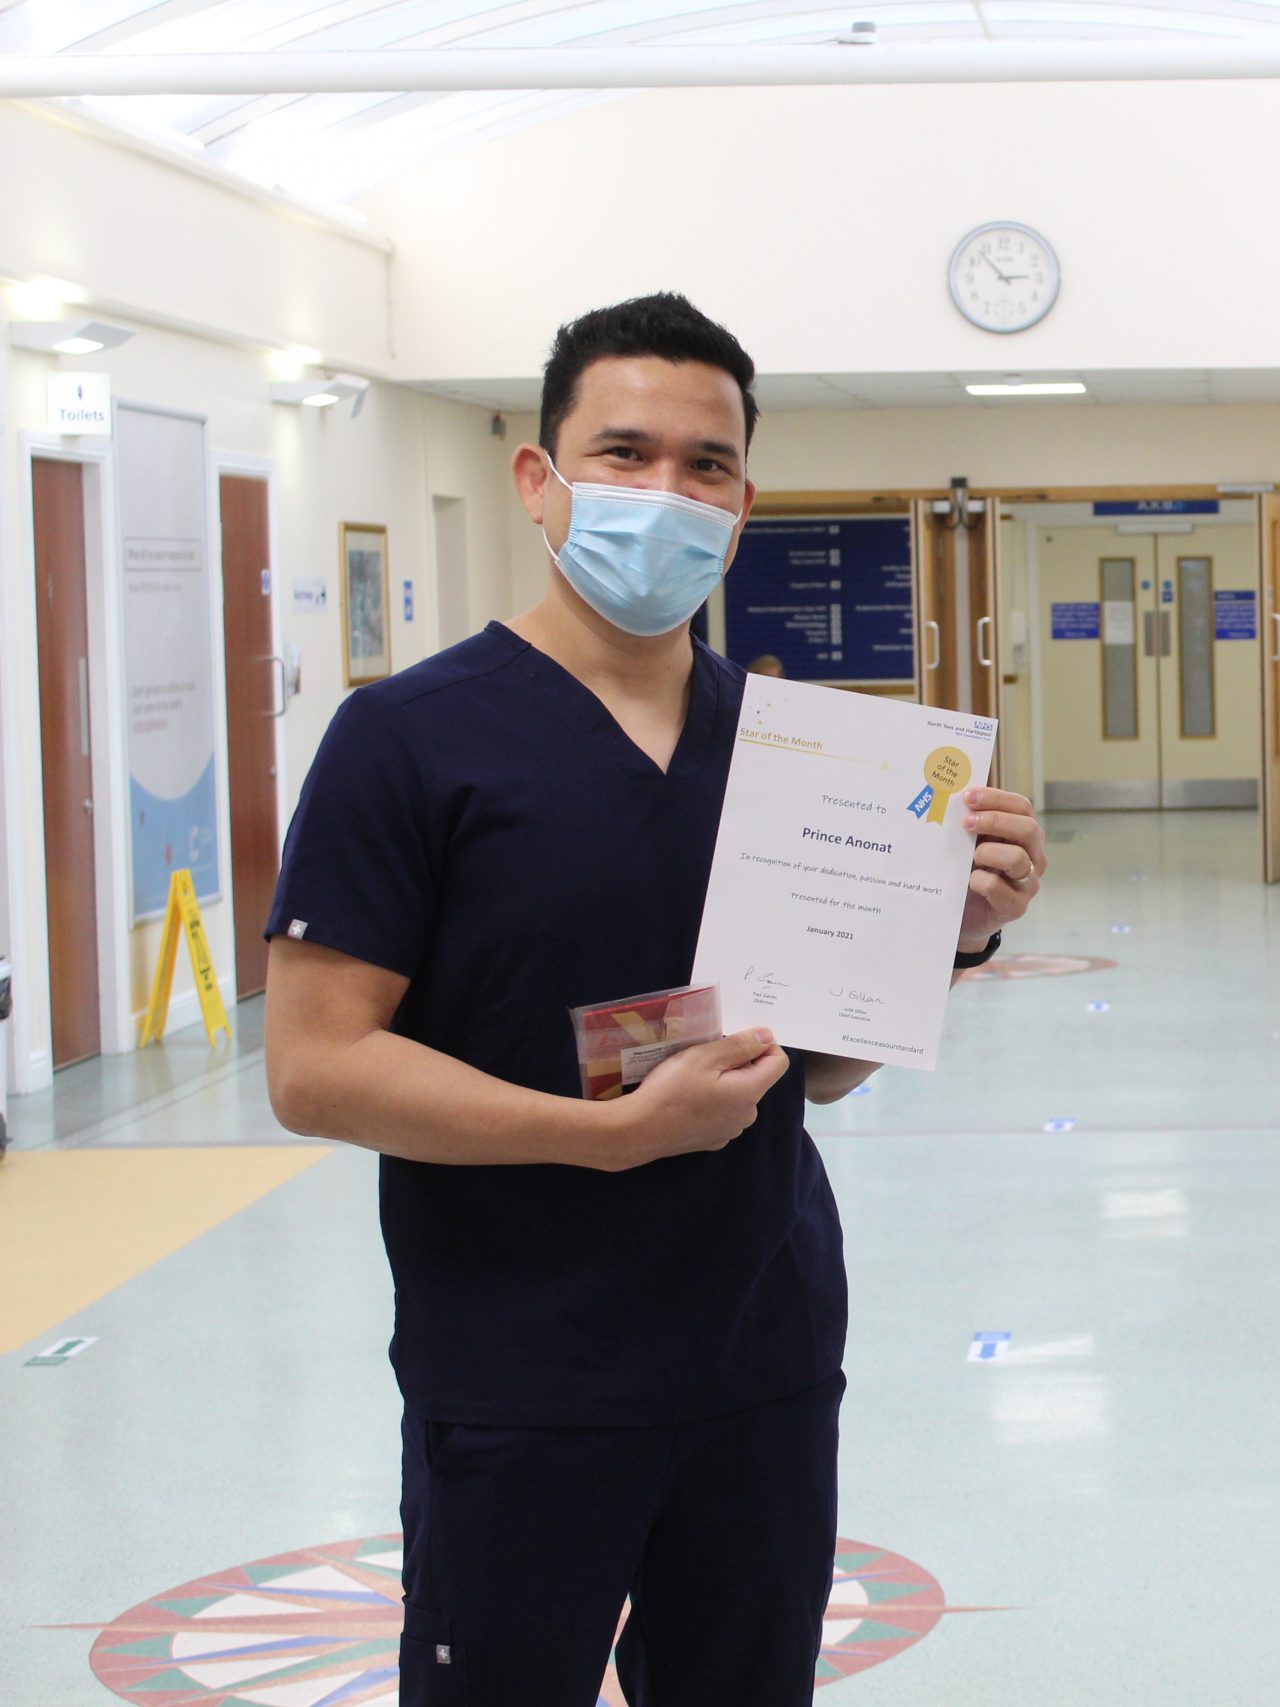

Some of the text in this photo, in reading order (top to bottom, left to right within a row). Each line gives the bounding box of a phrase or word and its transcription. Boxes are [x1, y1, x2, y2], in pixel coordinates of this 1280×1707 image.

[59, 408, 104, 421] Toilets
[974, 721, 993, 731] NHS
[740, 727, 823, 749] Star of the Month
[944, 756, 960, 768] Star
[932, 771, 955, 786] Month
[937, 764, 958, 778] of the
[821, 794, 887, 814] Presented to
[914, 791, 932, 812] NHS
[802, 827, 893, 853] Prince Anonat
[740, 852, 750, 860] In
[752, 855, 791, 868] recognition
[793, 861, 801, 870] of
[803, 865, 818, 873] your
[887, 880, 902, 888] and
[903, 881, 921, 891] hard
[791, 892, 881, 914] Presented for the month
[806, 925, 854, 940] January 2021
